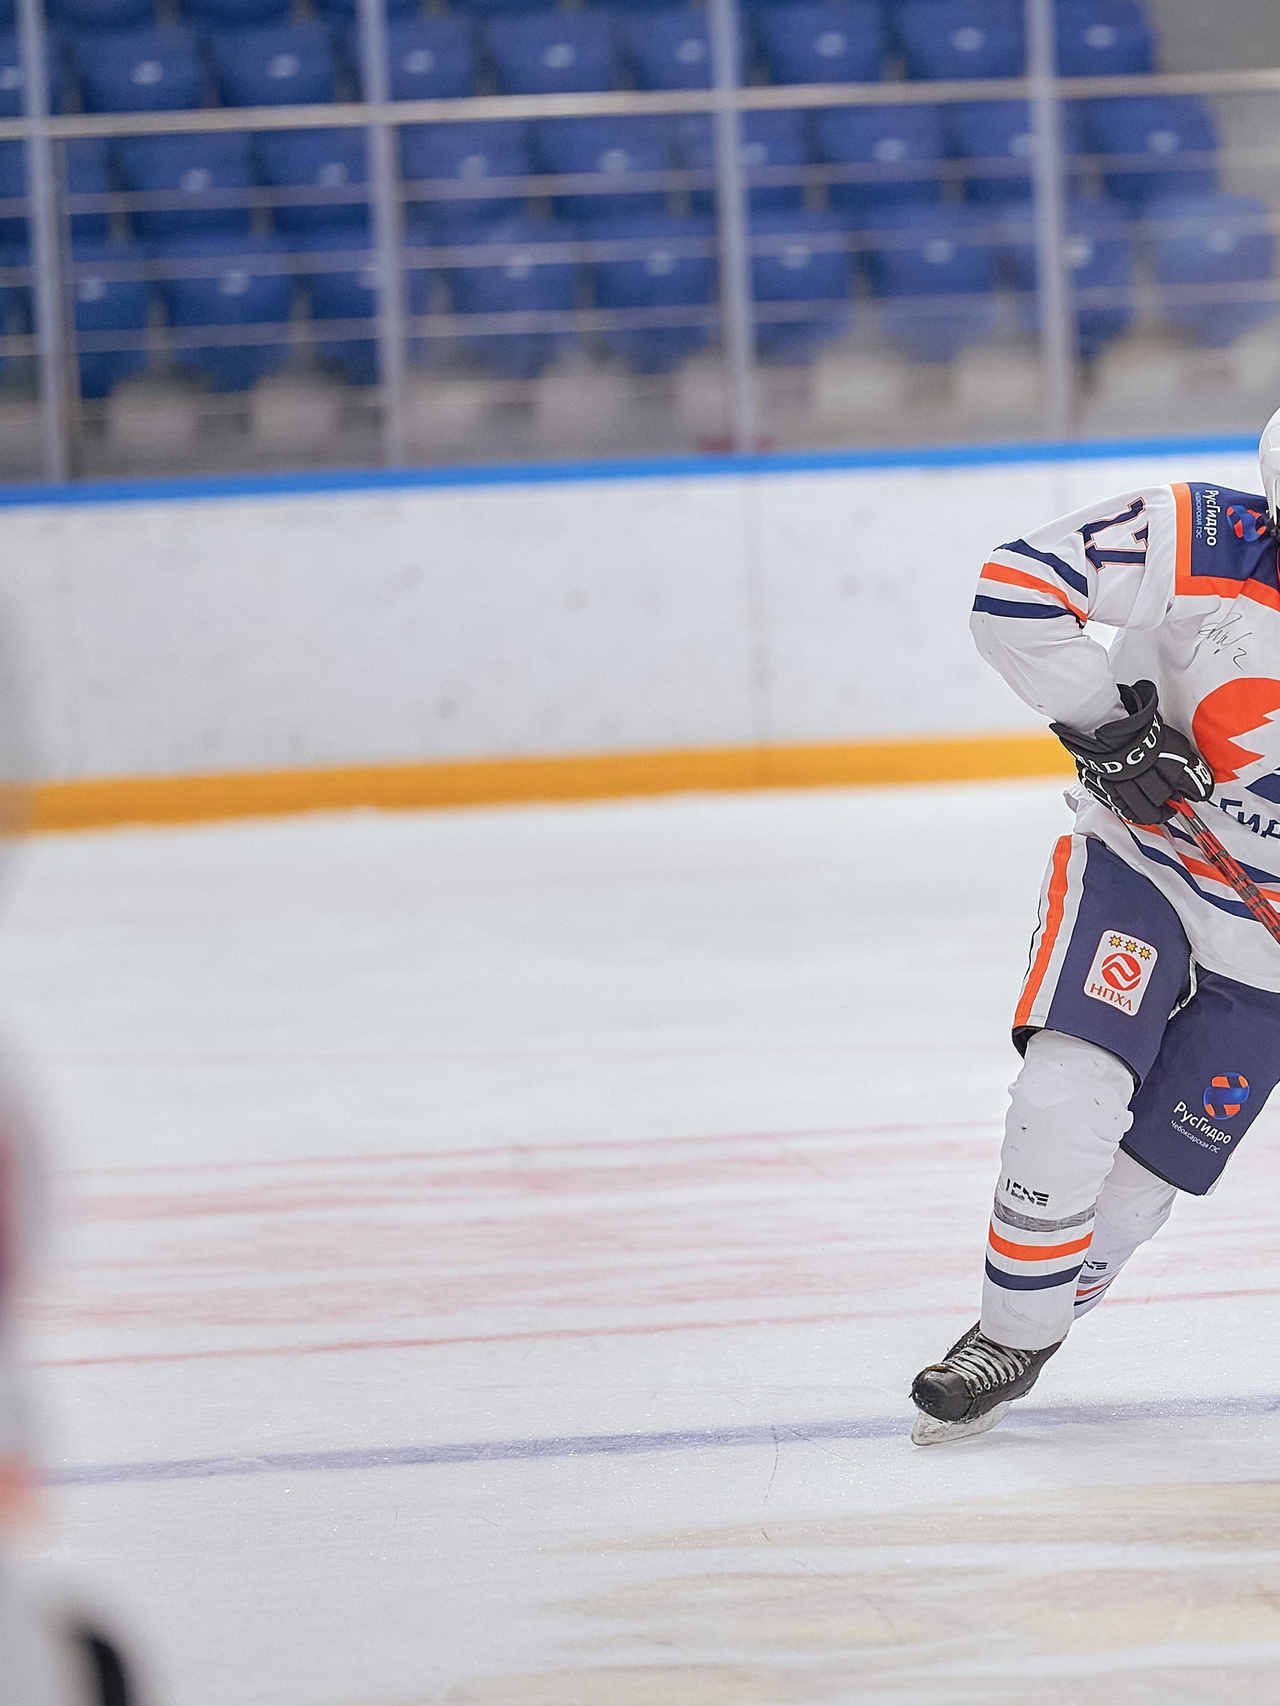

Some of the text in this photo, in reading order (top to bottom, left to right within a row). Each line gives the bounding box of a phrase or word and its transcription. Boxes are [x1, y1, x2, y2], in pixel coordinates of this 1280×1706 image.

[1202, 489, 1221, 546] РусГидро
[1089, 983, 1133, 1012] НПХЛ
[1173, 1100, 1232, 1144] РусГидро
[1208, 1144, 1221, 1154] ГЭС
